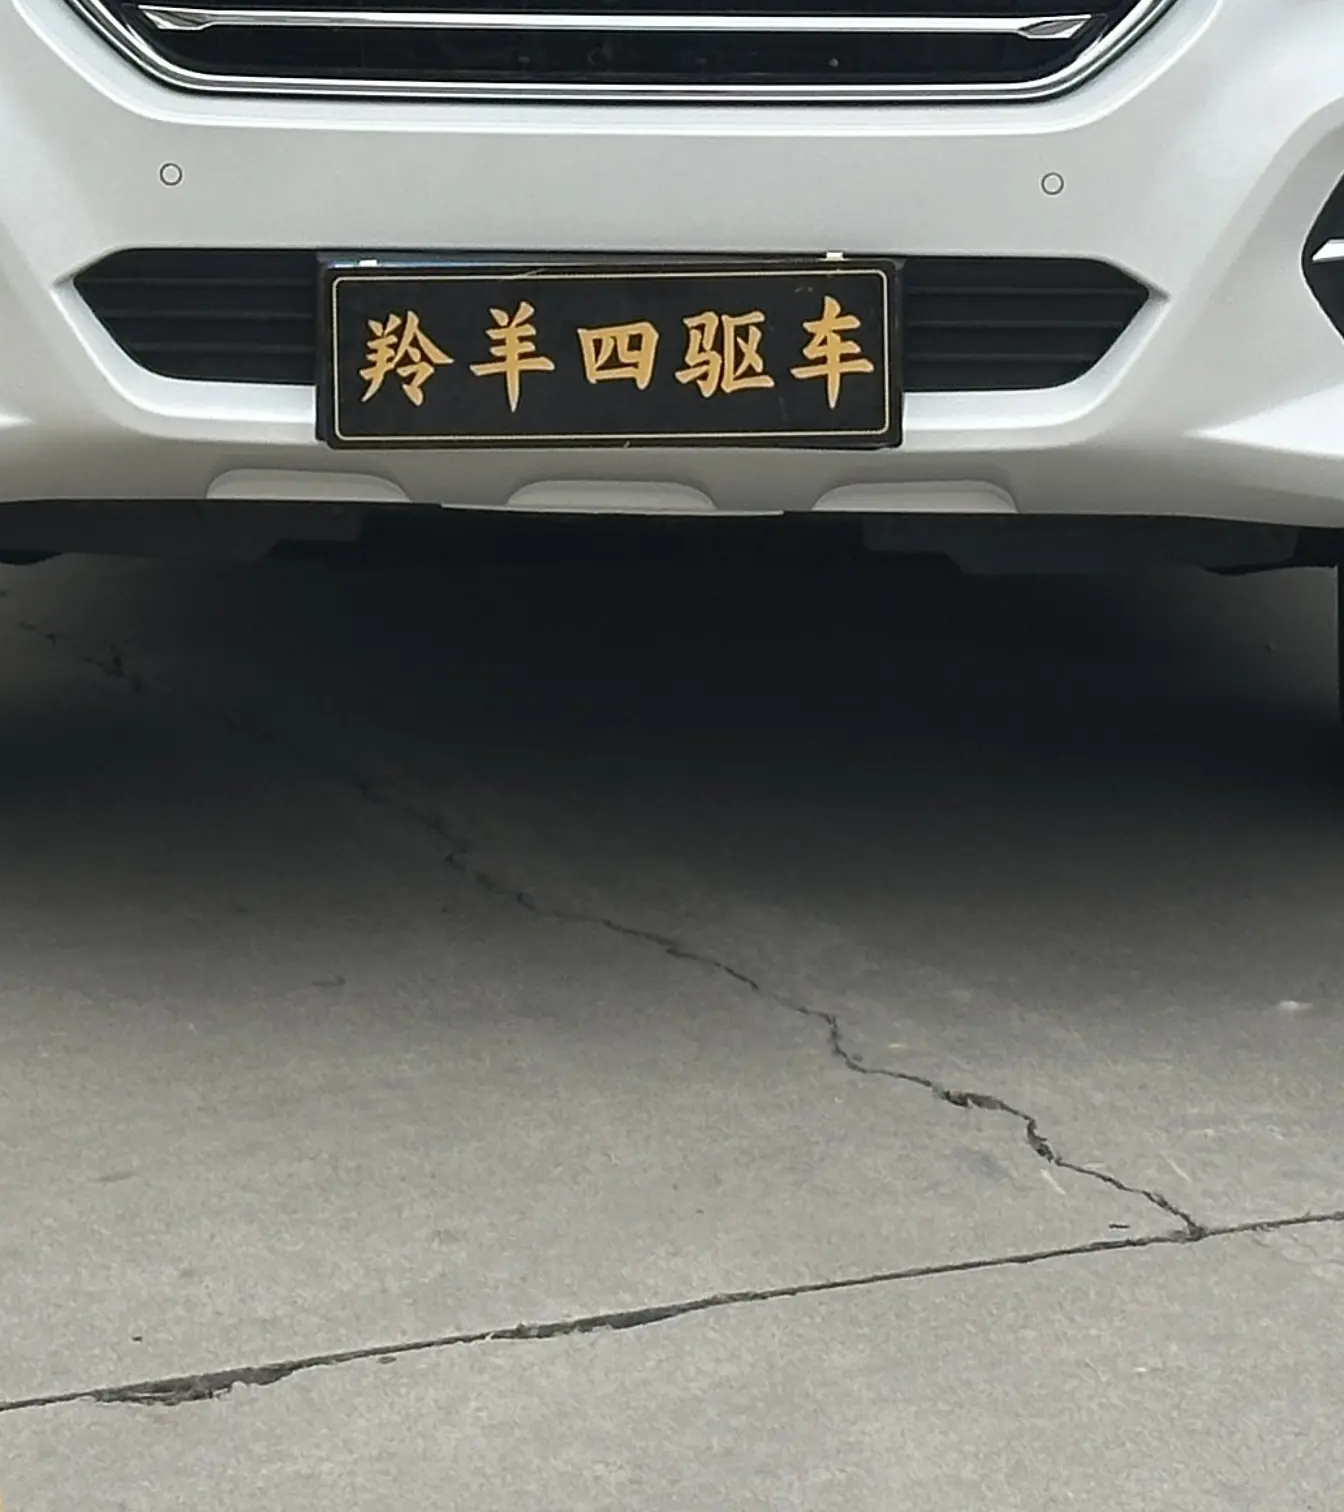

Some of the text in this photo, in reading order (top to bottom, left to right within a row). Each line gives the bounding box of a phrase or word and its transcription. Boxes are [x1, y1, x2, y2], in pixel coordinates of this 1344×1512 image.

[360, 295, 875, 413] 羚羊四驱车
